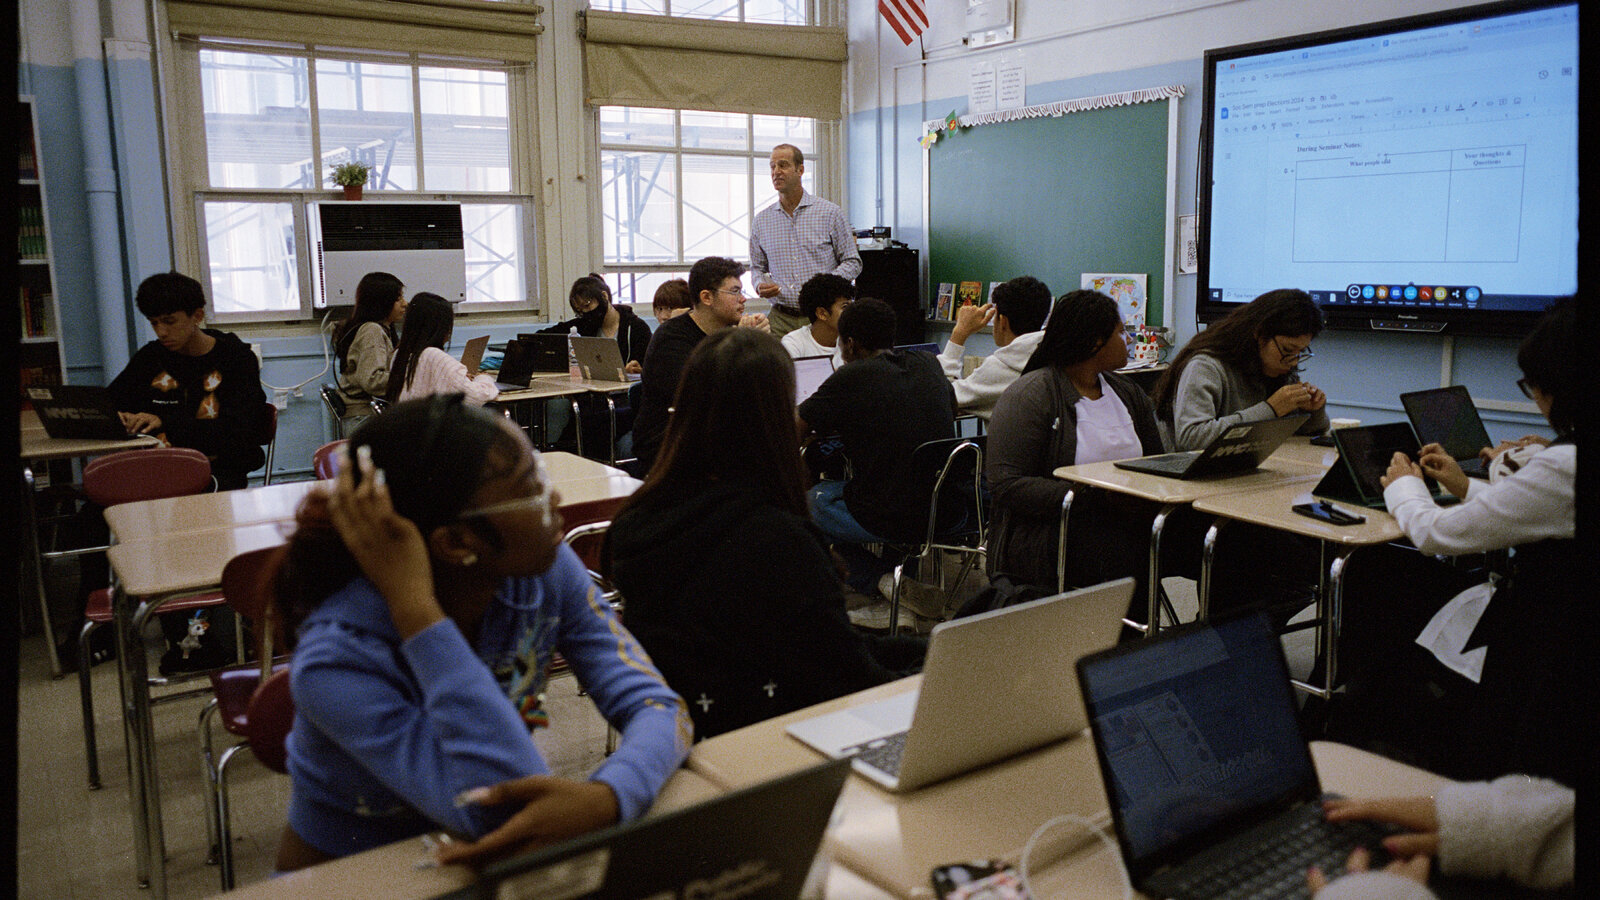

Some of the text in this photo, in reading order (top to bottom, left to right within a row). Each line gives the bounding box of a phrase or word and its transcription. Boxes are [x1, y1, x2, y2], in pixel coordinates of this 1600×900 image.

[1266, 99, 1290, 107] Elections
[1290, 96, 1304, 104] 2024
[1364, 159, 1380, 167] people
